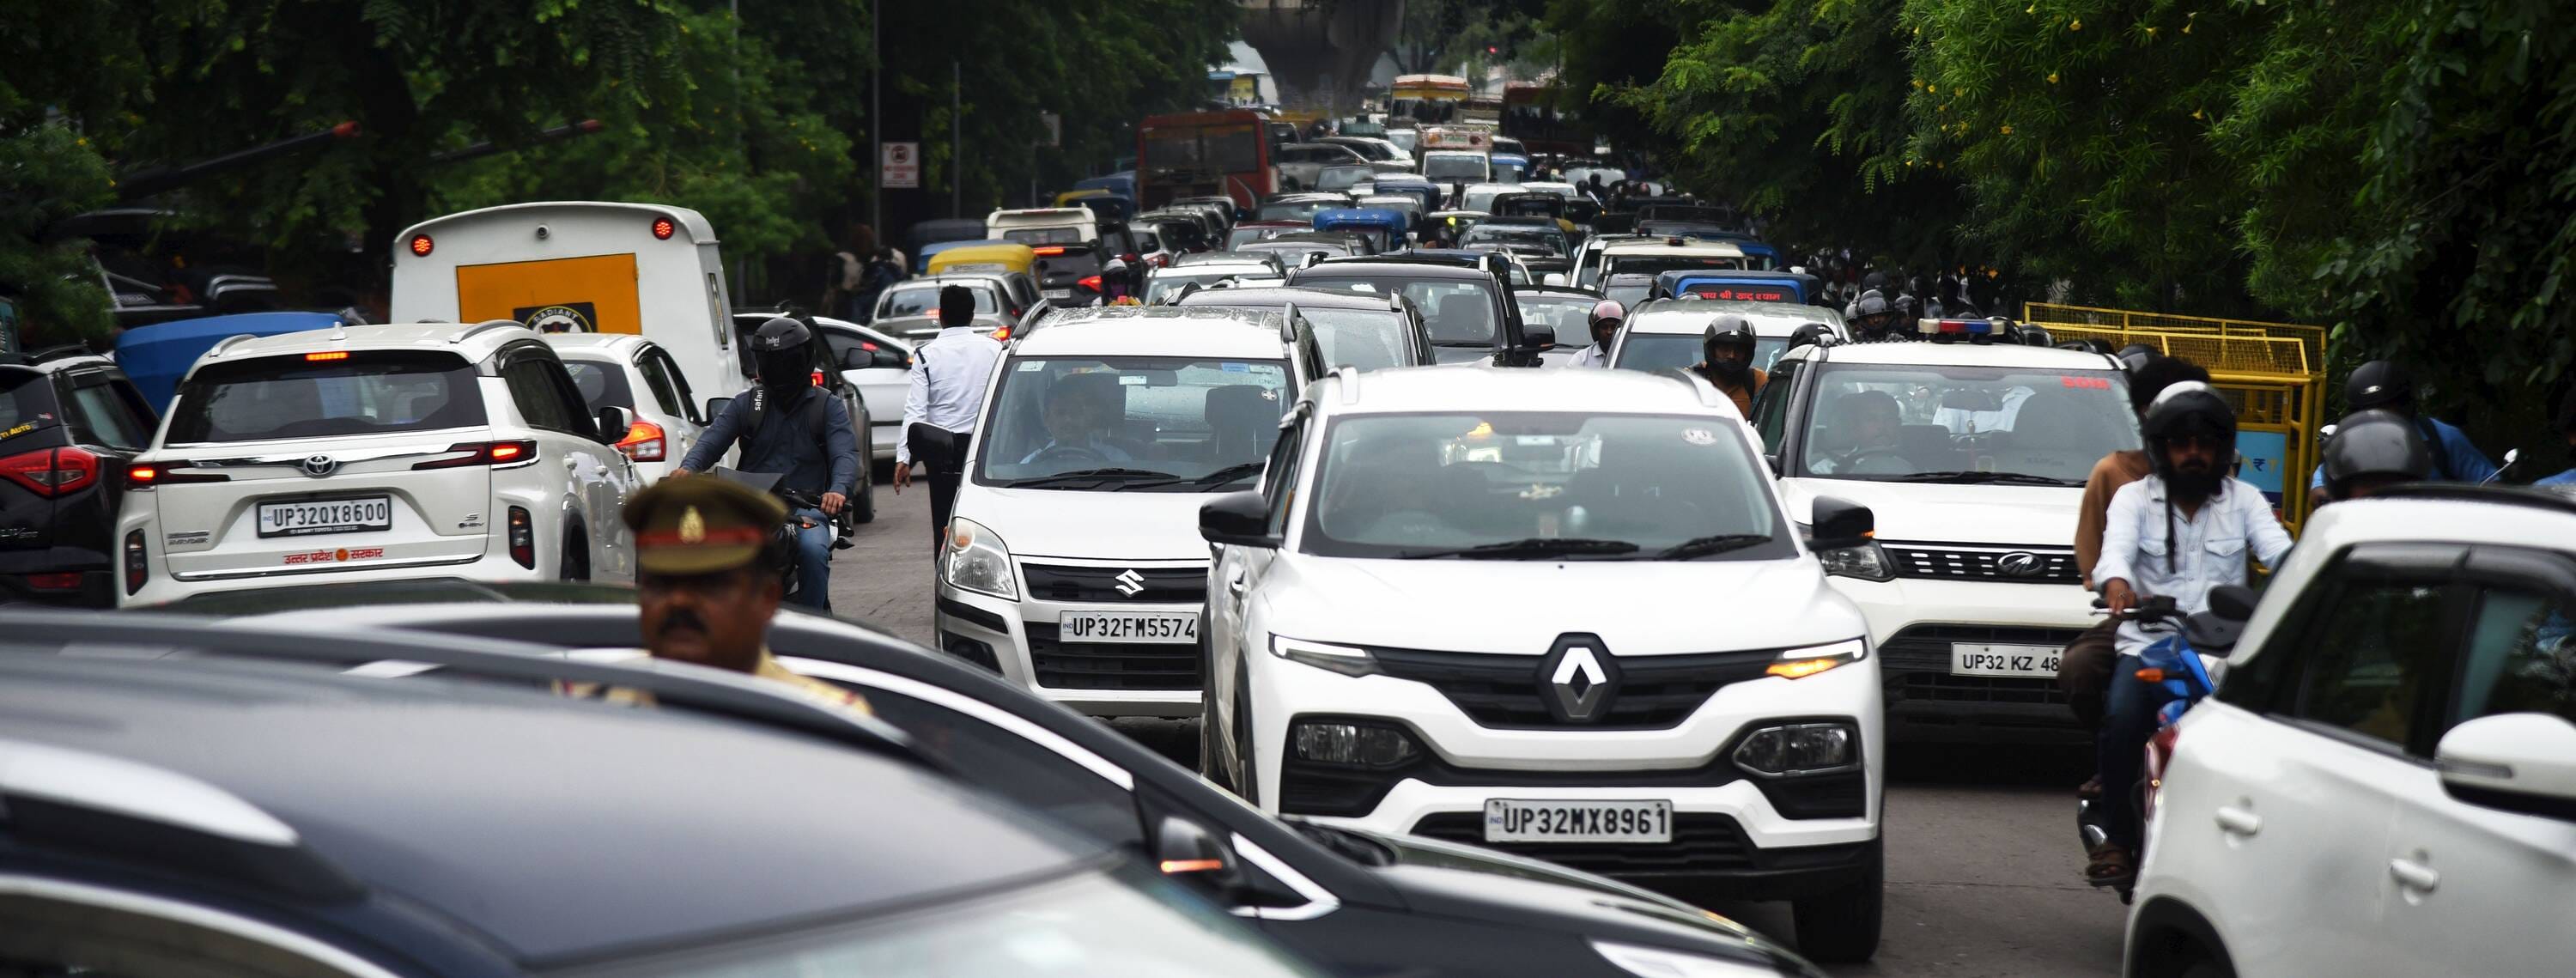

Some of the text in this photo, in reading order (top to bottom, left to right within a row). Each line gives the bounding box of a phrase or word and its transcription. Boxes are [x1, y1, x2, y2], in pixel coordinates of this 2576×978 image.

[534, 308, 579, 323] RADIANT
[754, 389, 764, 411] safari
[10, 424, 33, 435] AUTO
[274, 503, 386, 526] UP32QX8600
[284, 548, 384, 564] उत्तर प्रदेश सरकार
[1073, 617, 1195, 638] UP32FM5574
[1963, 653, 2059, 671] UP32 KZ 48
[1504, 807, 1666, 835] UP32MX8961
